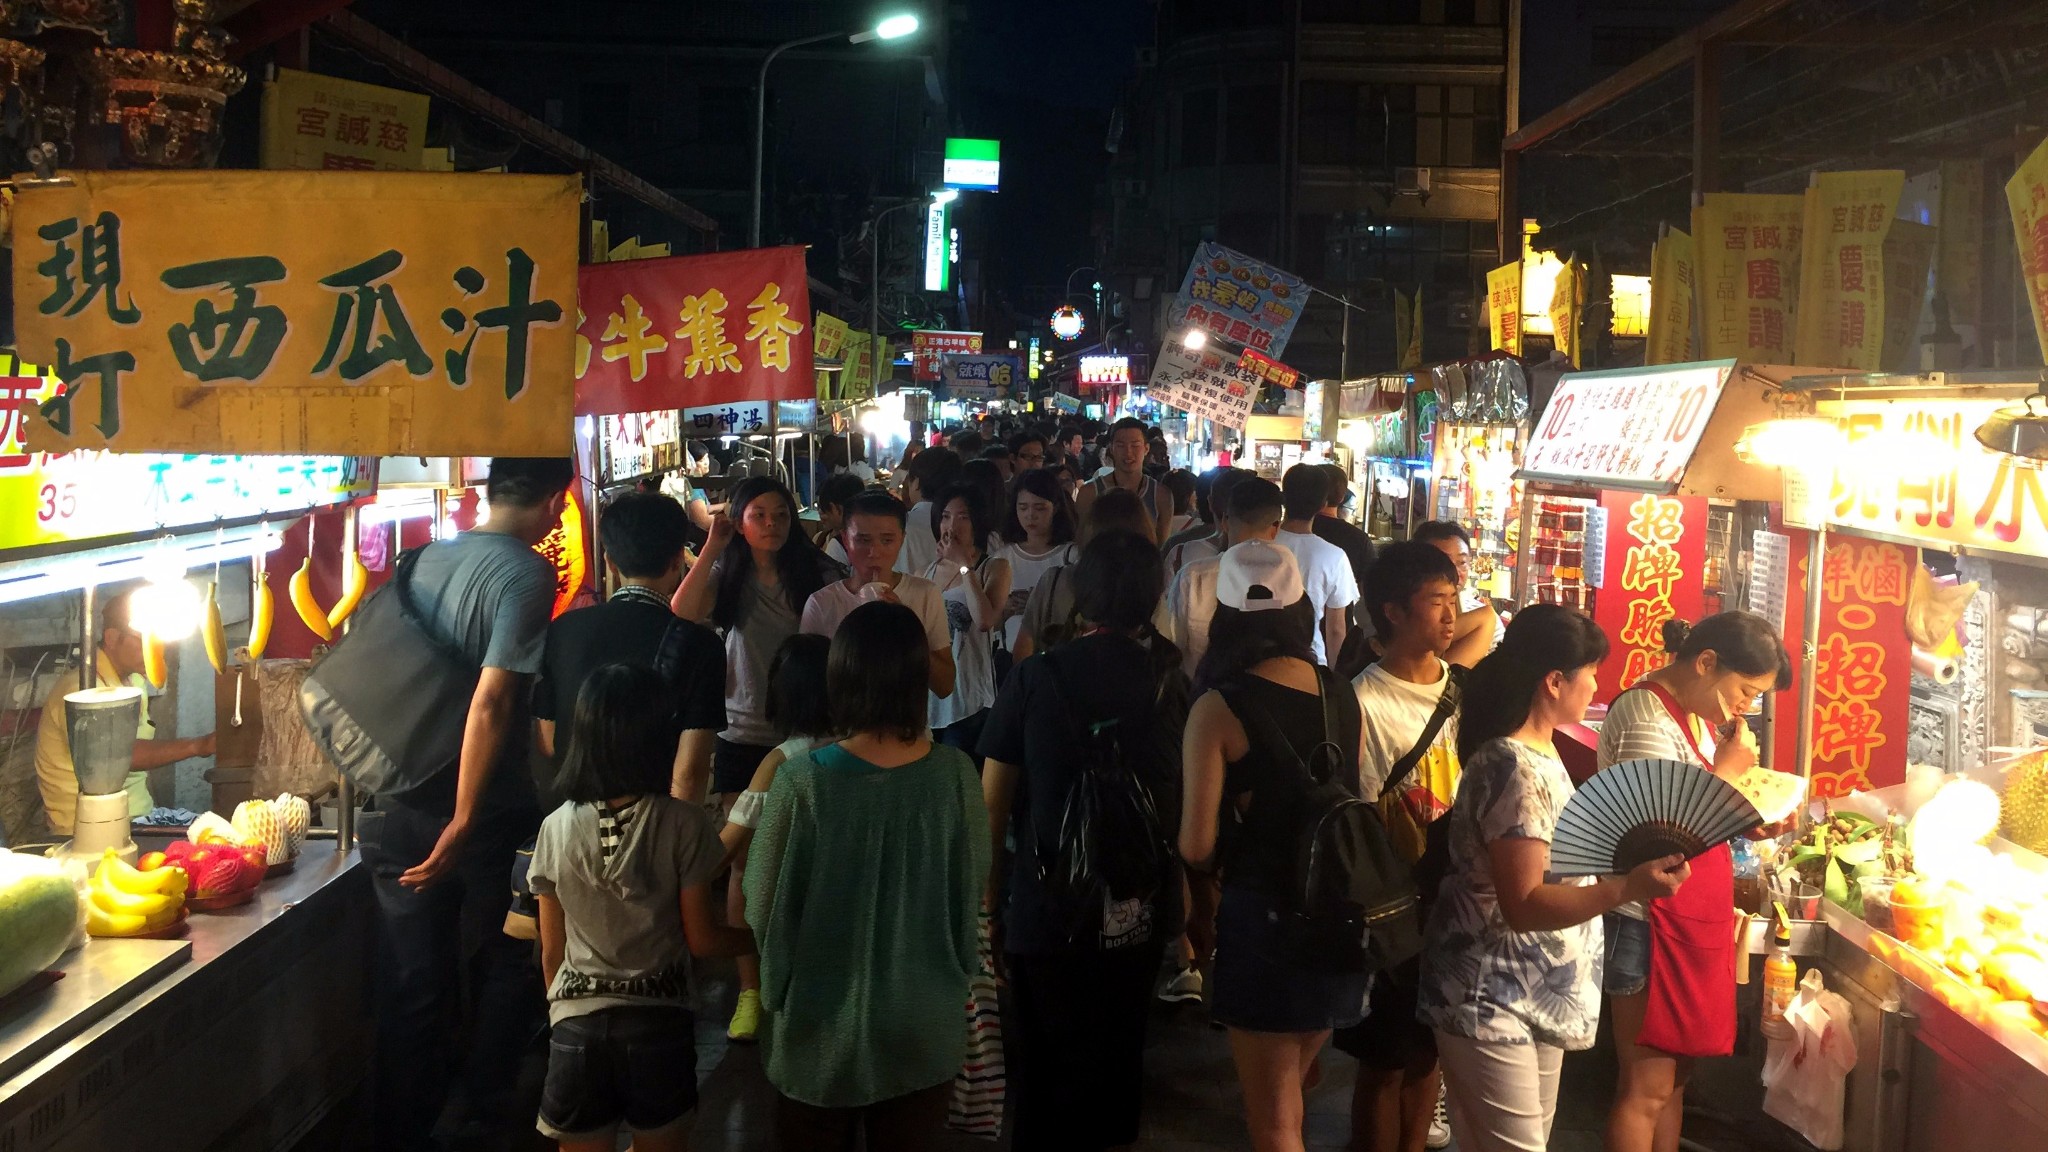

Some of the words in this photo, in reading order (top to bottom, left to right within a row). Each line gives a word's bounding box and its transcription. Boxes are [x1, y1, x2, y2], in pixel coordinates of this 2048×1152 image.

[930, 208, 943, 272] FamilM
[37, 211, 141, 440] 現打
[160, 247, 564, 402] 西瓜汁
[1185, 303, 1273, 350] 內有座位
[1157, 370, 1249, 411] 永久重複使用
[1663, 385, 1708, 443] 10
[693, 407, 763, 433] 四神湯
[1541, 393, 1575, 440] 10
[38, 484, 77, 522] 35
